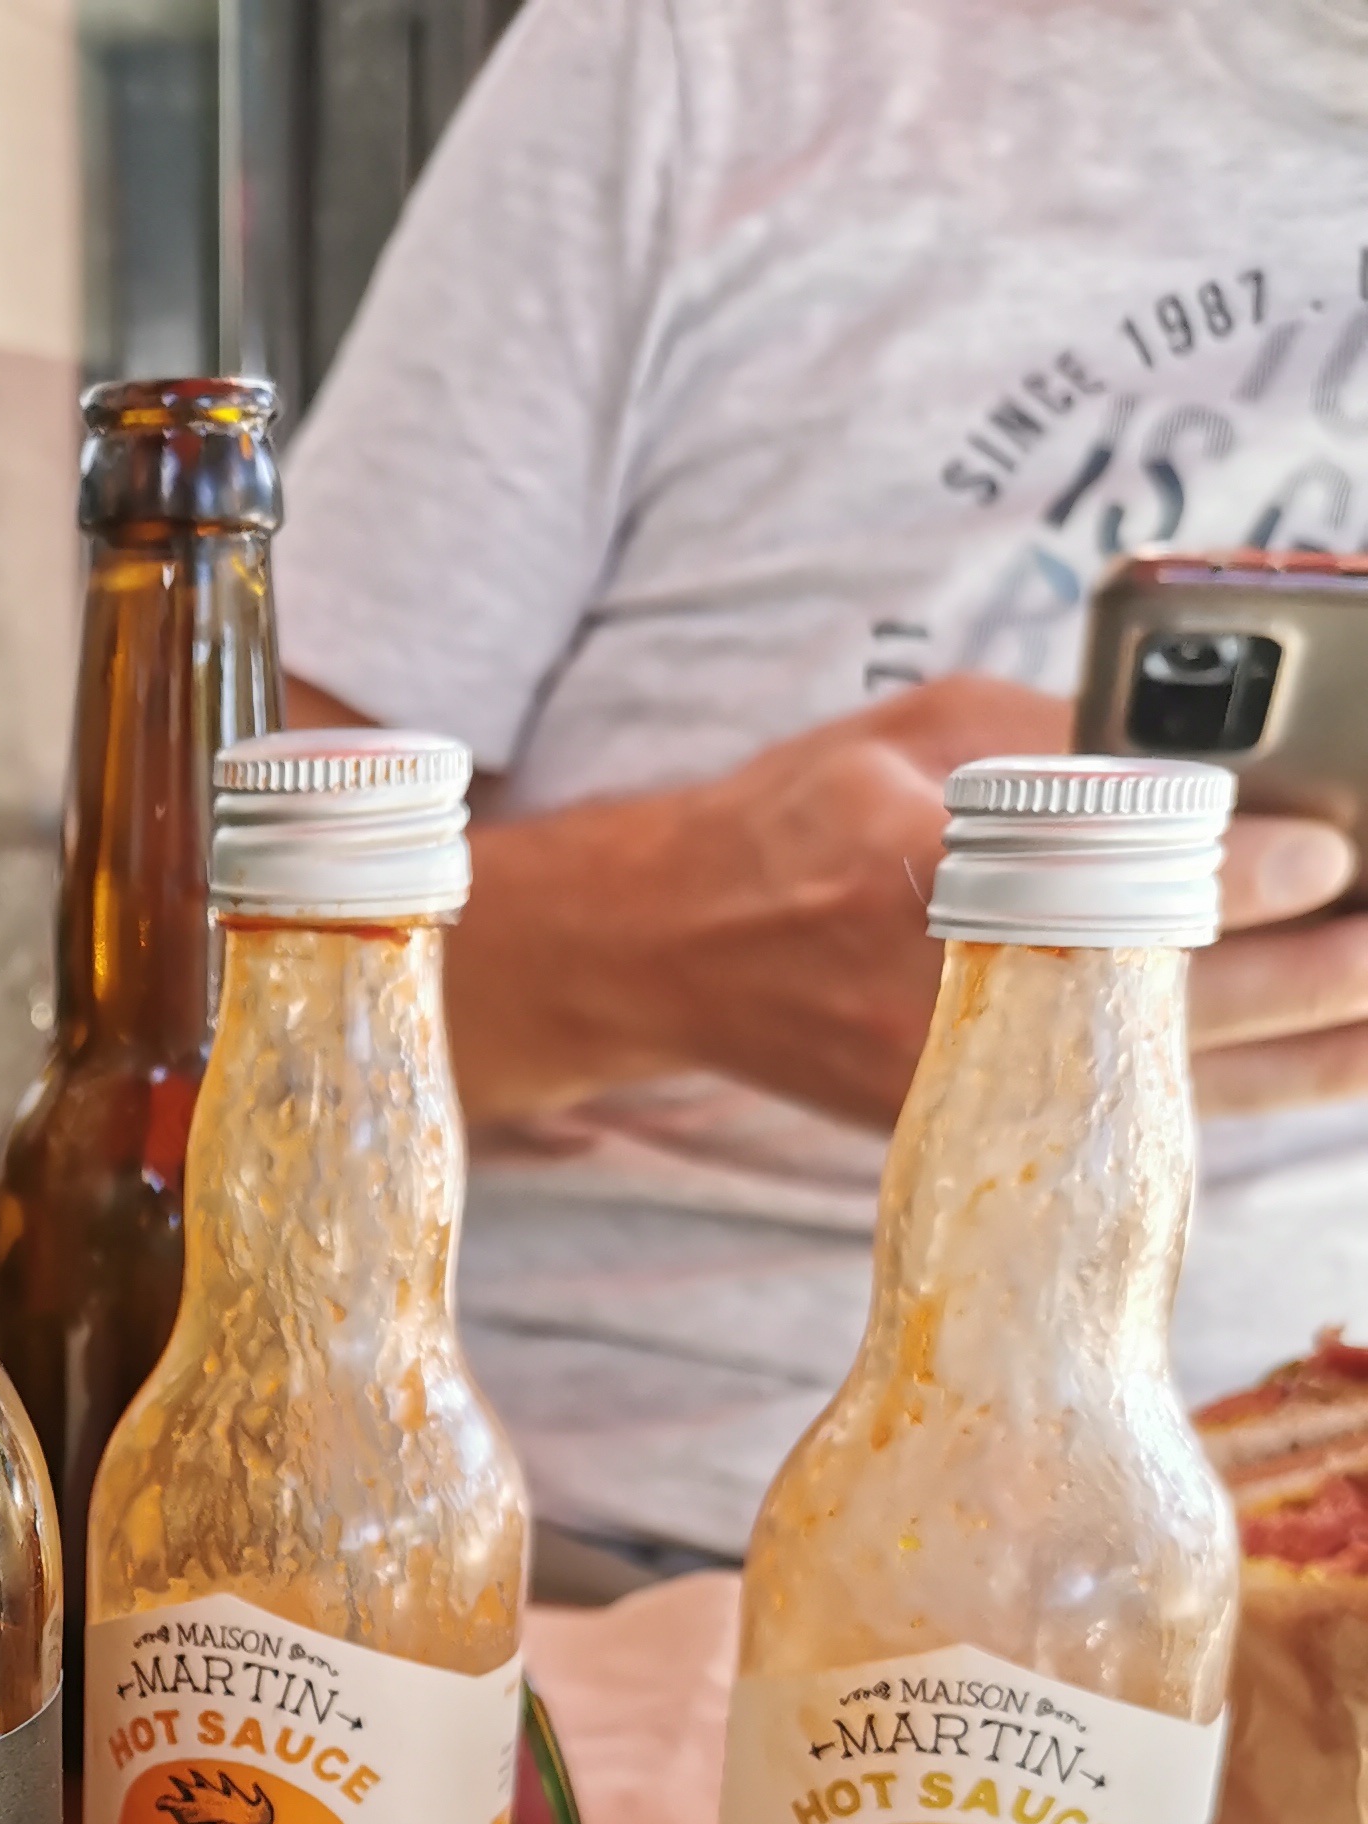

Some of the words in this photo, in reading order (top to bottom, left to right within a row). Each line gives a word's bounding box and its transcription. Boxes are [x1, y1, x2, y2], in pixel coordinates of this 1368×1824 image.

[941, 350, 1105, 507] SINCE
[1120, 268, 1266, 369] 1987
[176, 1622, 284, 1658] MAISON
[131, 1654, 339, 1725] MARTIN
[899, 1678, 1029, 1714] MAISON
[108, 1709, 179, 1770] HOT
[197, 1709, 381, 1805] SAUCE
[833, 1712, 1085, 1784] MARTIN
